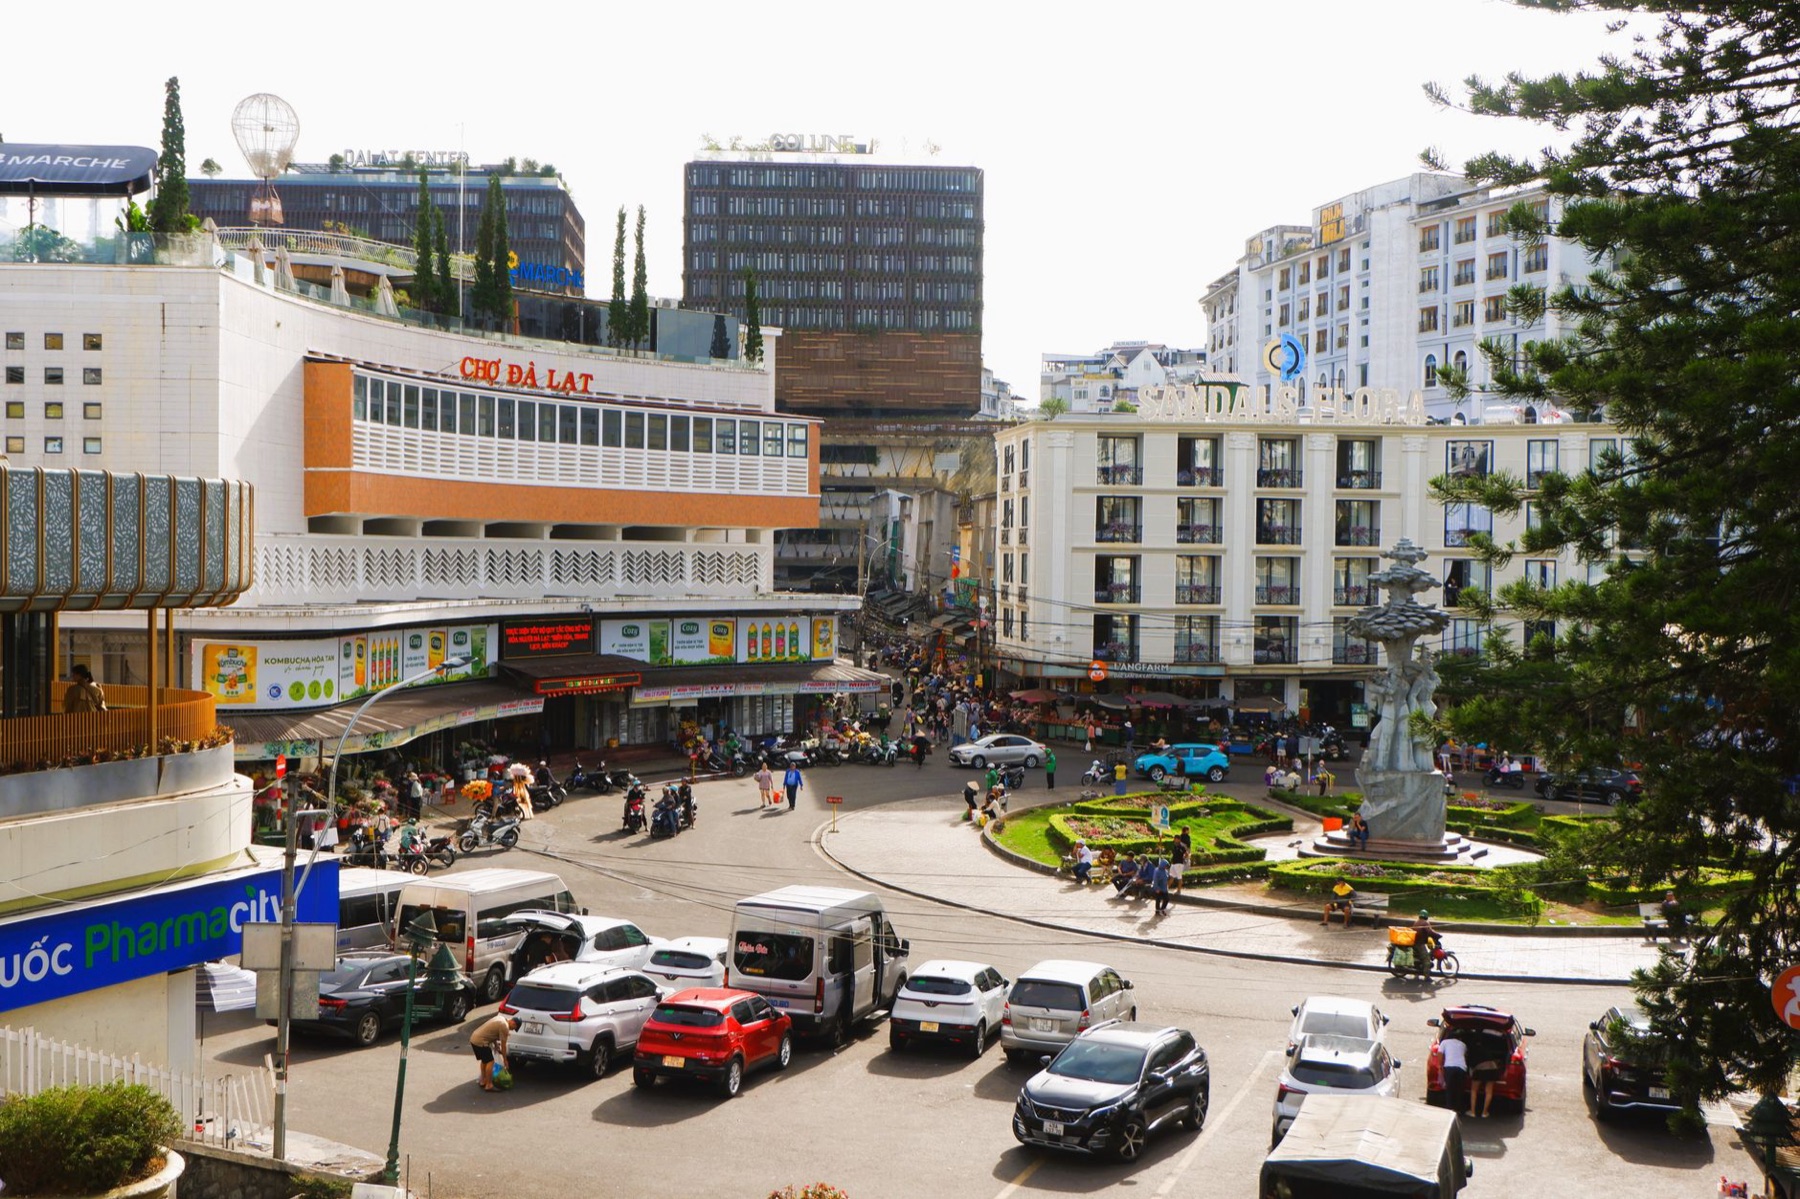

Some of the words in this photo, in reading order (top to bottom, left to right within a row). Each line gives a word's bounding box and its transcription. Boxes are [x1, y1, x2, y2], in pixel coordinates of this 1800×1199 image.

[769, 133, 854, 151] COLLINE
[459, 356, 502, 387] CHỢ
[506, 361, 538, 388] ĐÀ
[546, 369, 594, 396] LẠT
[1136, 383, 1298, 423] SANDALS
[1311, 385, 1429, 425] FLORA
[623, 626, 638, 636] Cozy
[682, 623, 698, 633] Cozy
[264, 656, 310, 665] KOMBUCHA
